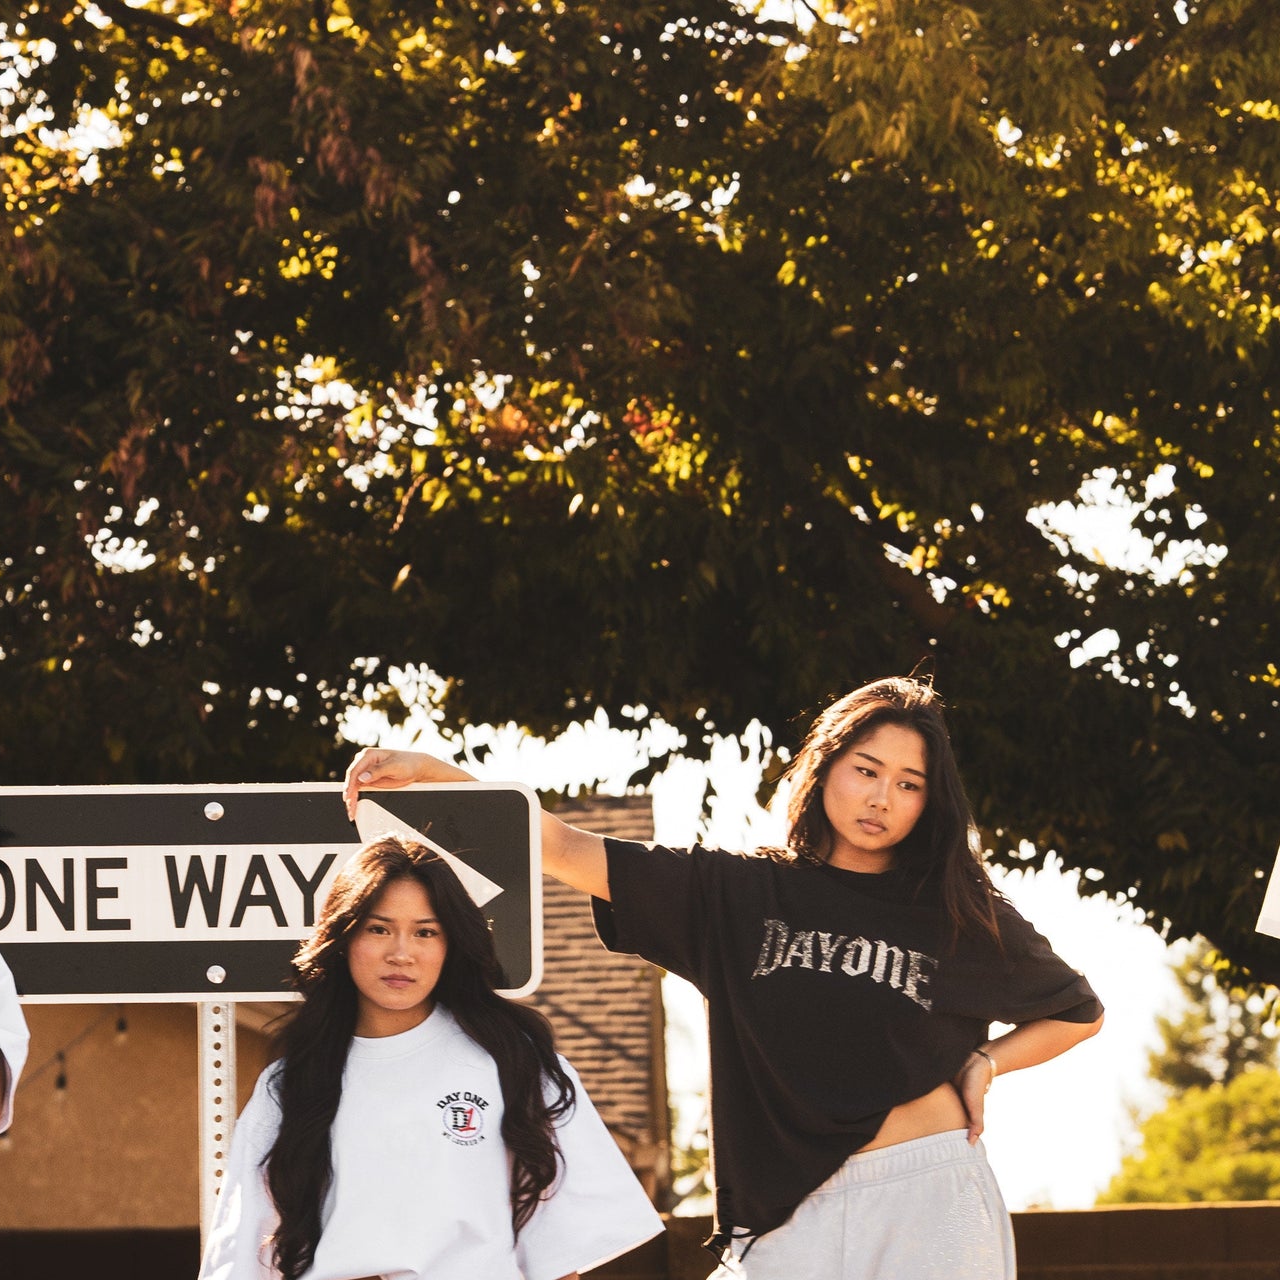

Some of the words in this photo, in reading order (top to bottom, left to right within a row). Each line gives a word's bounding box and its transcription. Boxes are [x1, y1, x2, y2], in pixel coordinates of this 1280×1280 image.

[165, 853, 338, 928] WAY
[751, 918, 940, 1012] DAYONE
[436, 1092, 461, 1109] DAY
[463, 1091, 489, 1110] ONE
